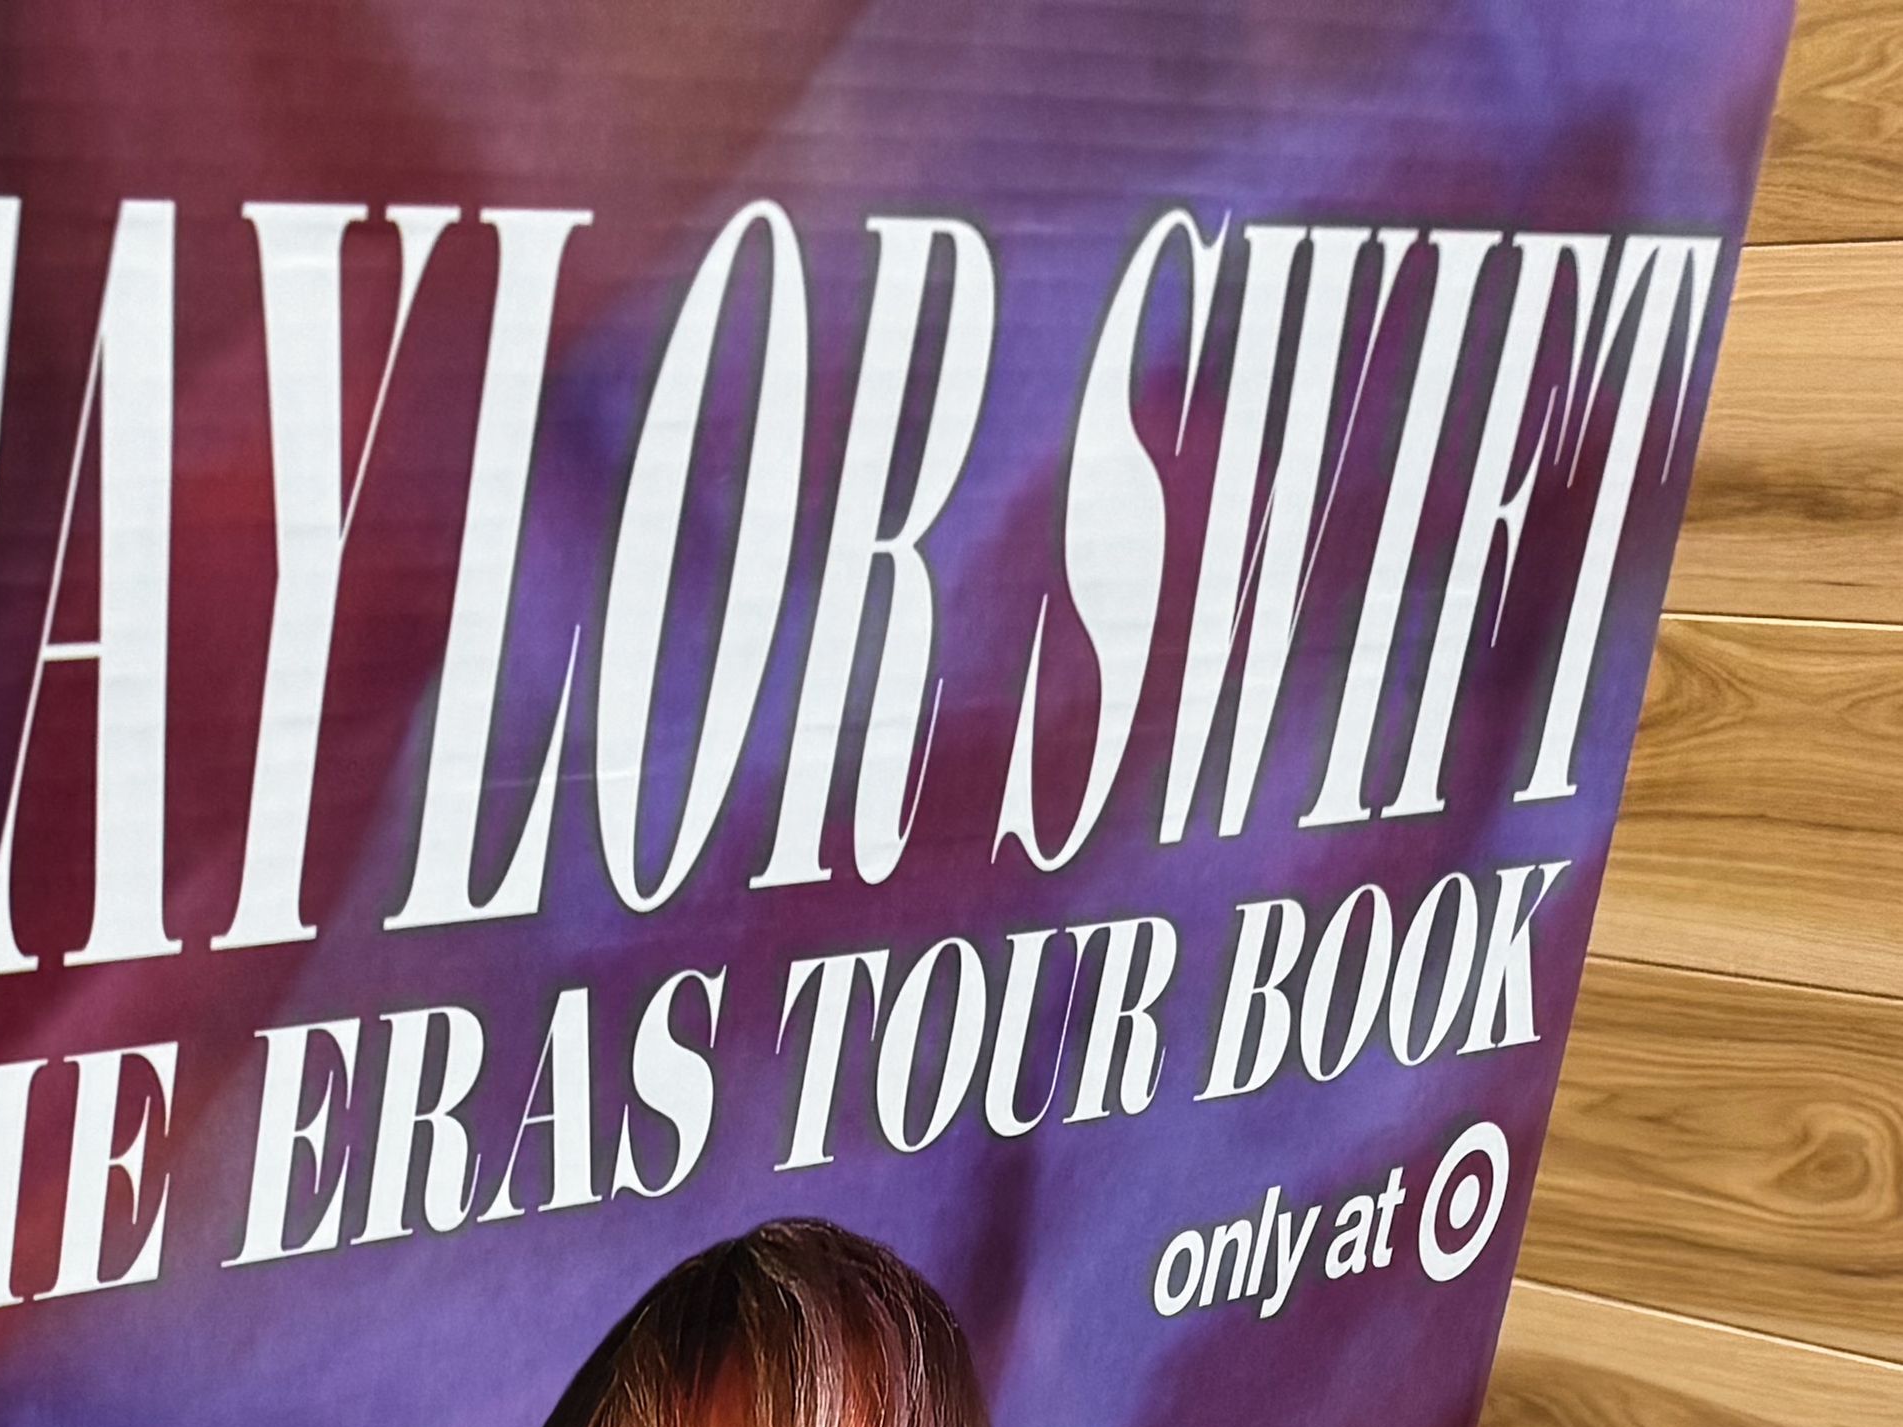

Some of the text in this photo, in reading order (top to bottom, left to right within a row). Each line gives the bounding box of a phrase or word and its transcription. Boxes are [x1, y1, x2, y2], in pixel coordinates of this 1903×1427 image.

[990, 208, 1723, 870] SWIFT
[220, 966, 728, 1268] ERAS
[769, 912, 1181, 1170] TOUR
[1193, 860, 1565, 1104] BOOK
[1153, 1166, 1406, 1319] only at
